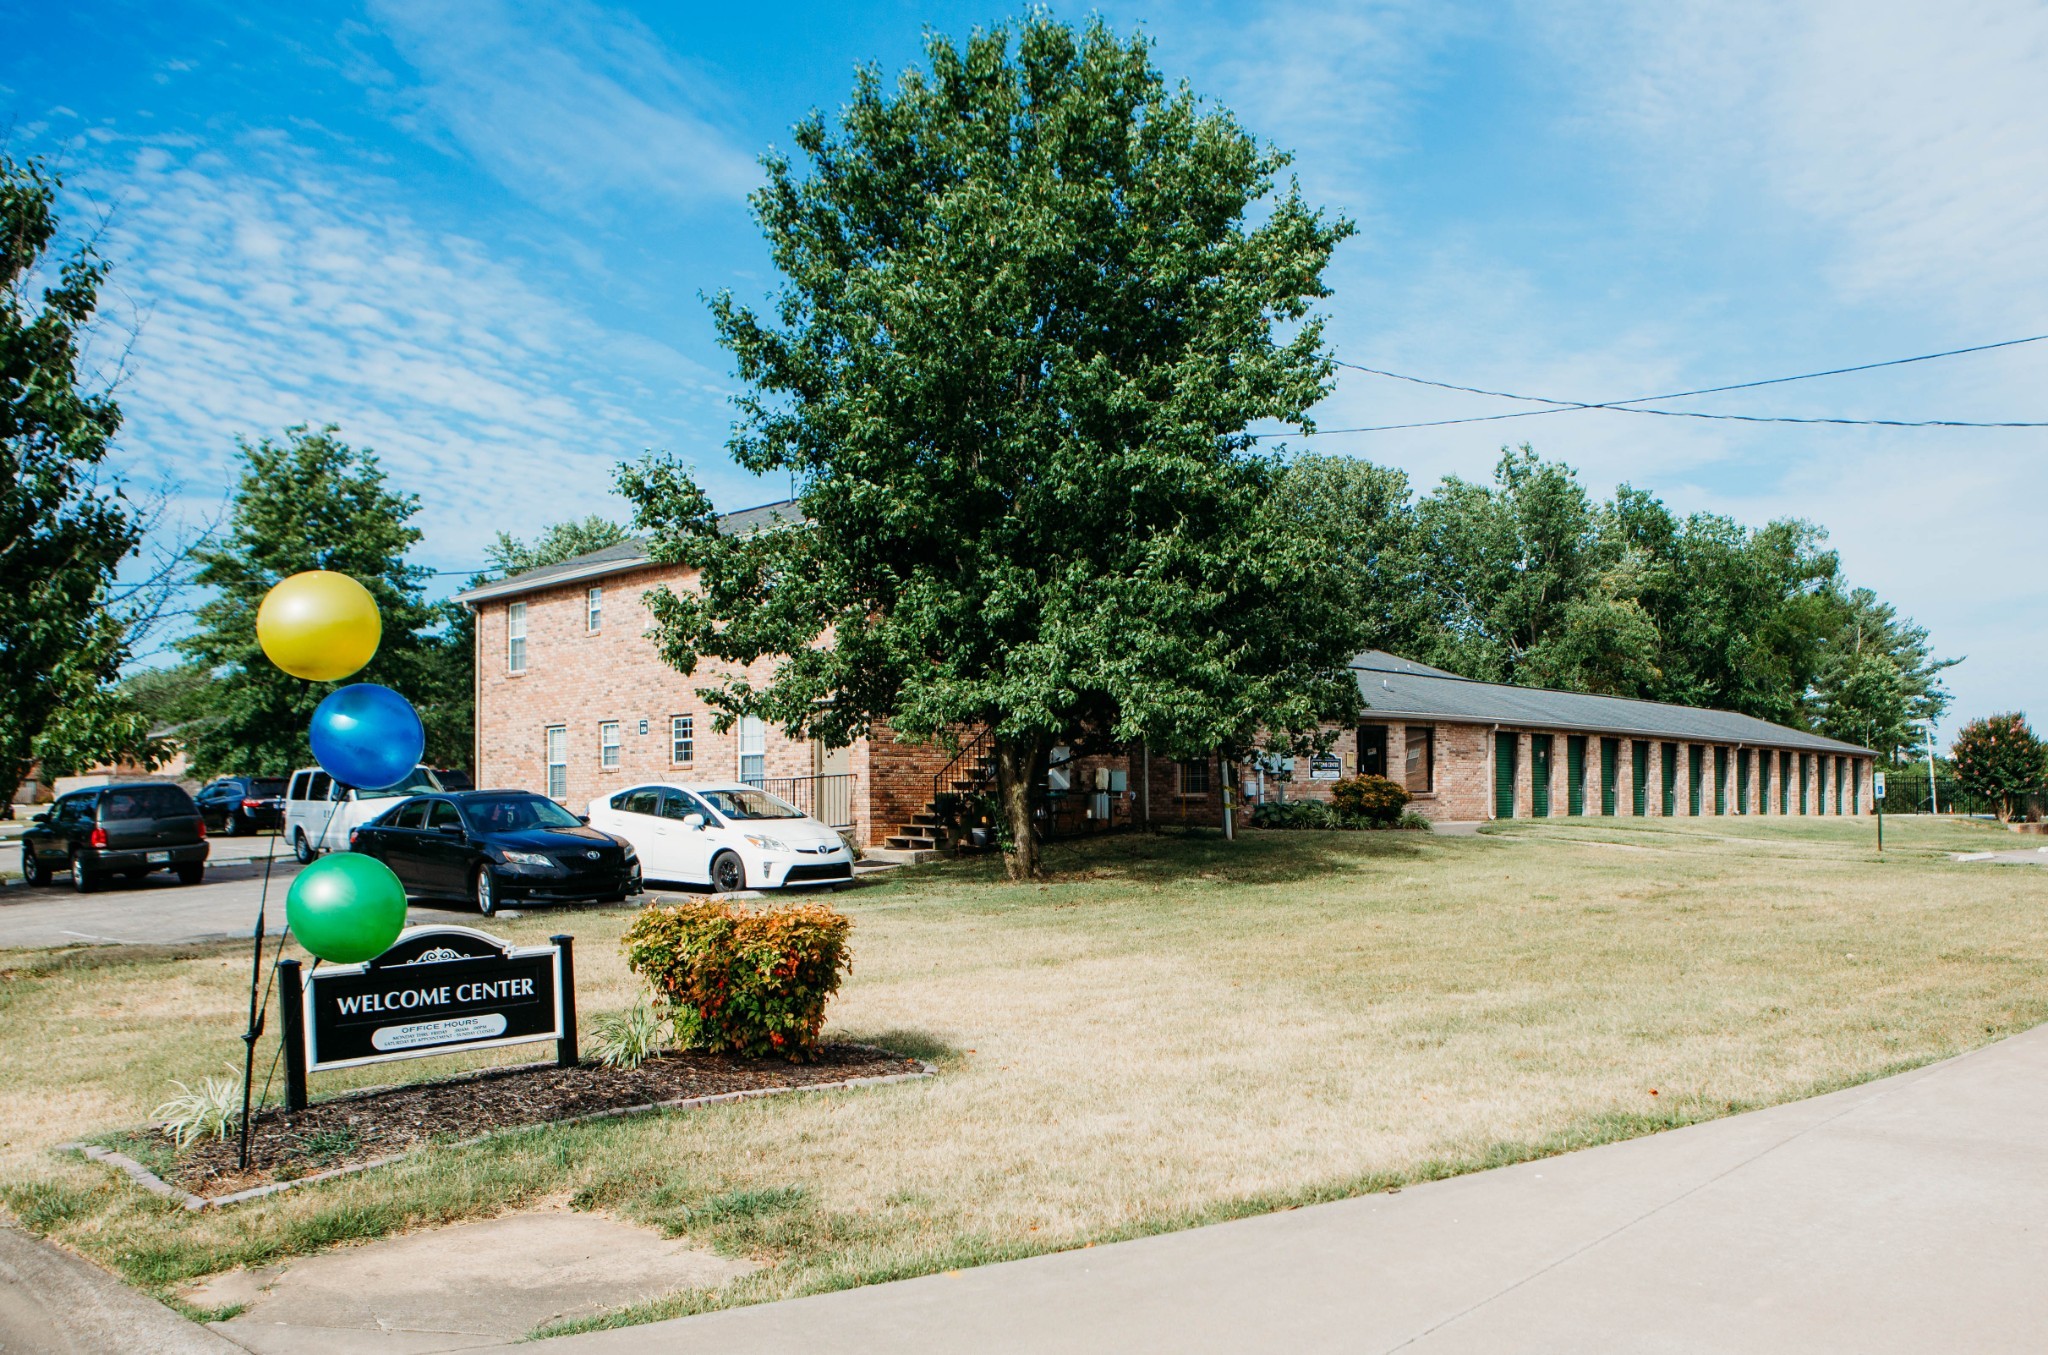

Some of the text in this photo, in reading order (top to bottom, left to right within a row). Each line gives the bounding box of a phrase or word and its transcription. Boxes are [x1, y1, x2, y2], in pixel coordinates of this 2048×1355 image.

[337, 978, 535, 1015] WELCOME CENTER
[401, 1018, 479, 1034] OFFICE HOURS
[418, 1034, 453, 1042] APPOINTMENT
